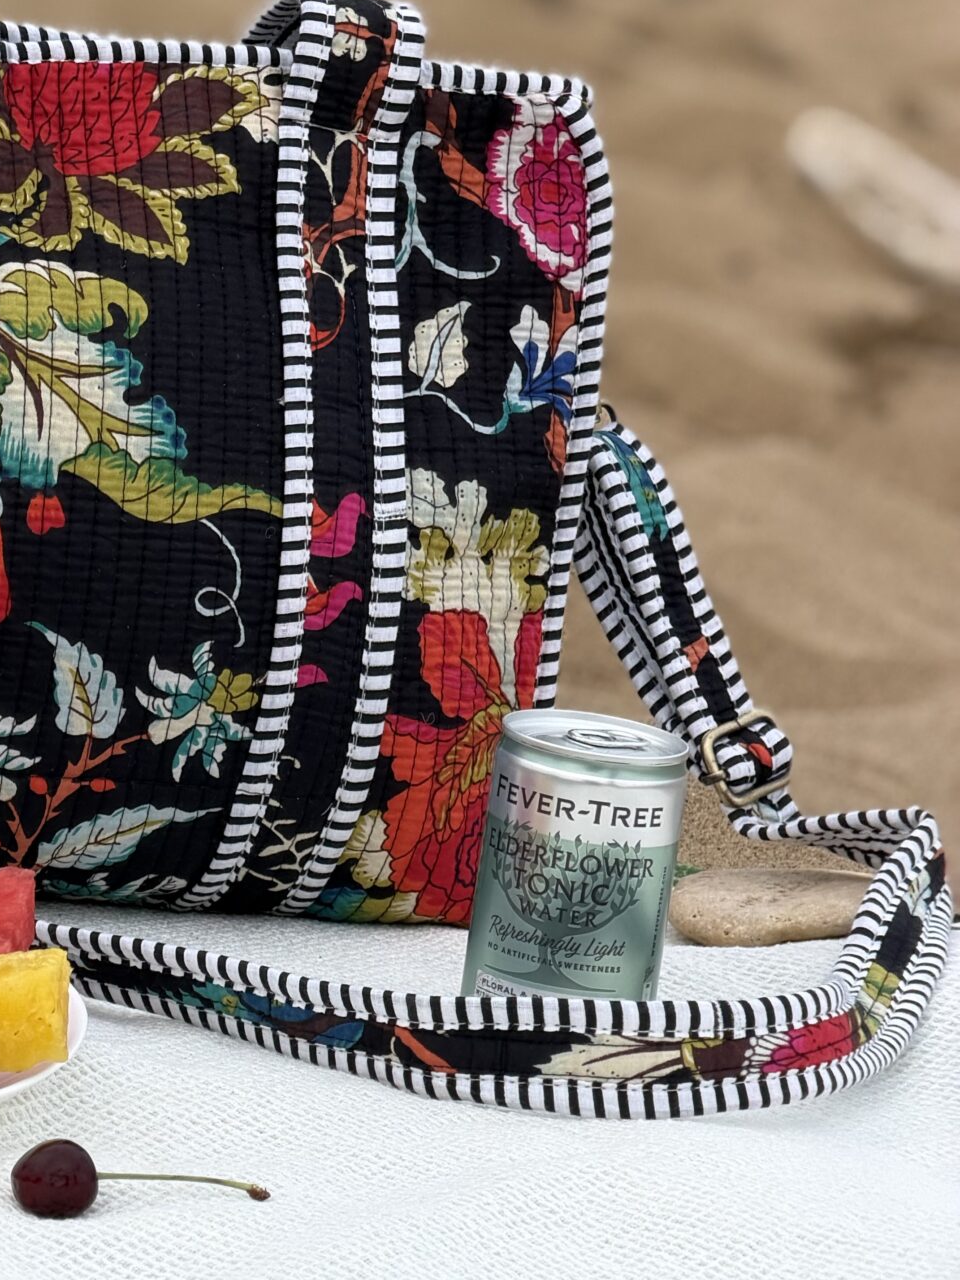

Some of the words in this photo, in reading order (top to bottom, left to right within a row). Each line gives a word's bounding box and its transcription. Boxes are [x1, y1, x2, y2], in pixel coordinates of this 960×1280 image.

[496, 773, 663, 828] FEVER-TREE
[489, 828, 654, 879] ELDERFLOWER
[514, 866, 609, 907] TONIC
[517, 894, 598, 929] WATER
[487, 941, 499, 951] NO
[500, 946, 554, 967] ARTIFICIAL
[558, 961, 622, 974] SWEETENERS
[489, 914, 581, 958] Refreshingly
[583, 937, 626, 962] Light
[481, 977, 517, 997] FLORAL
